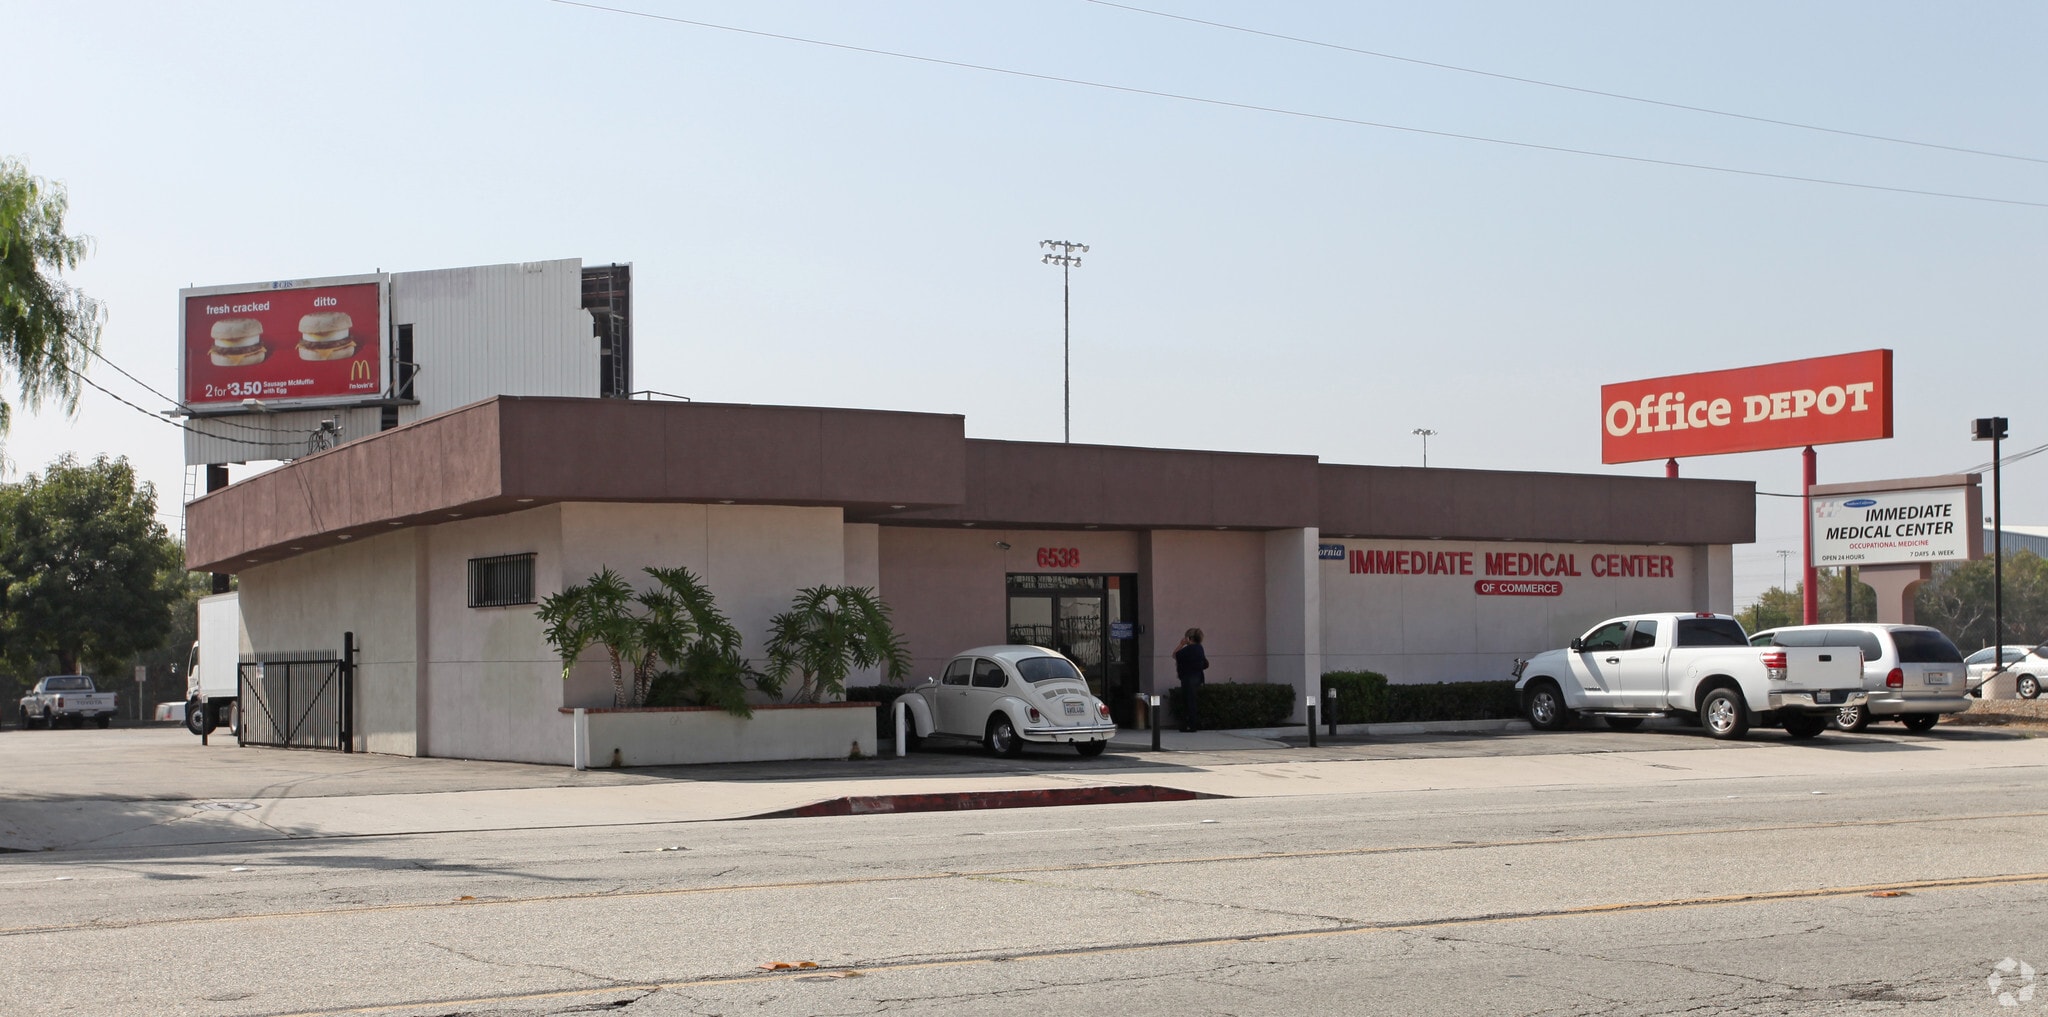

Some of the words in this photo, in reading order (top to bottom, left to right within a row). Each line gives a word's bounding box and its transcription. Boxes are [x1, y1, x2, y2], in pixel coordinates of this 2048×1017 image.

[278, 280, 293, 289] CBS
[206, 304, 230, 315] fresh
[232, 301, 270, 313] cracked
[313, 296, 337, 307] ditto
[205, 384, 213, 398] 2
[214, 386, 227, 397] for
[227, 381, 262, 396] $3.50
[263, 380, 287, 388] Sausage
[287, 378, 315, 387] McMuffin
[276, 387, 287, 395] Egg
[1605, 391, 1732, 437] Office
[1742, 381, 1874, 424] DEPOT
[1865, 503, 1953, 523] IMMEDIATE
[1825, 524, 1892, 541] MEDICAL
[1895, 520, 1954, 537] CENTER
[1849, 541, 1897, 550] OCCUPATIONAL
[1898, 539, 1929, 548] MEDICINE
[1037, 547, 1080, 568] 6538
[1350, 550, 1473, 576] IMMEDIATE
[1485, 552, 1581, 577] MEDICAL
[1591, 553, 1674, 578] CENTER
[1481, 583, 1495, 593] OF
[1499, 583, 1558, 594] COMMERCE
